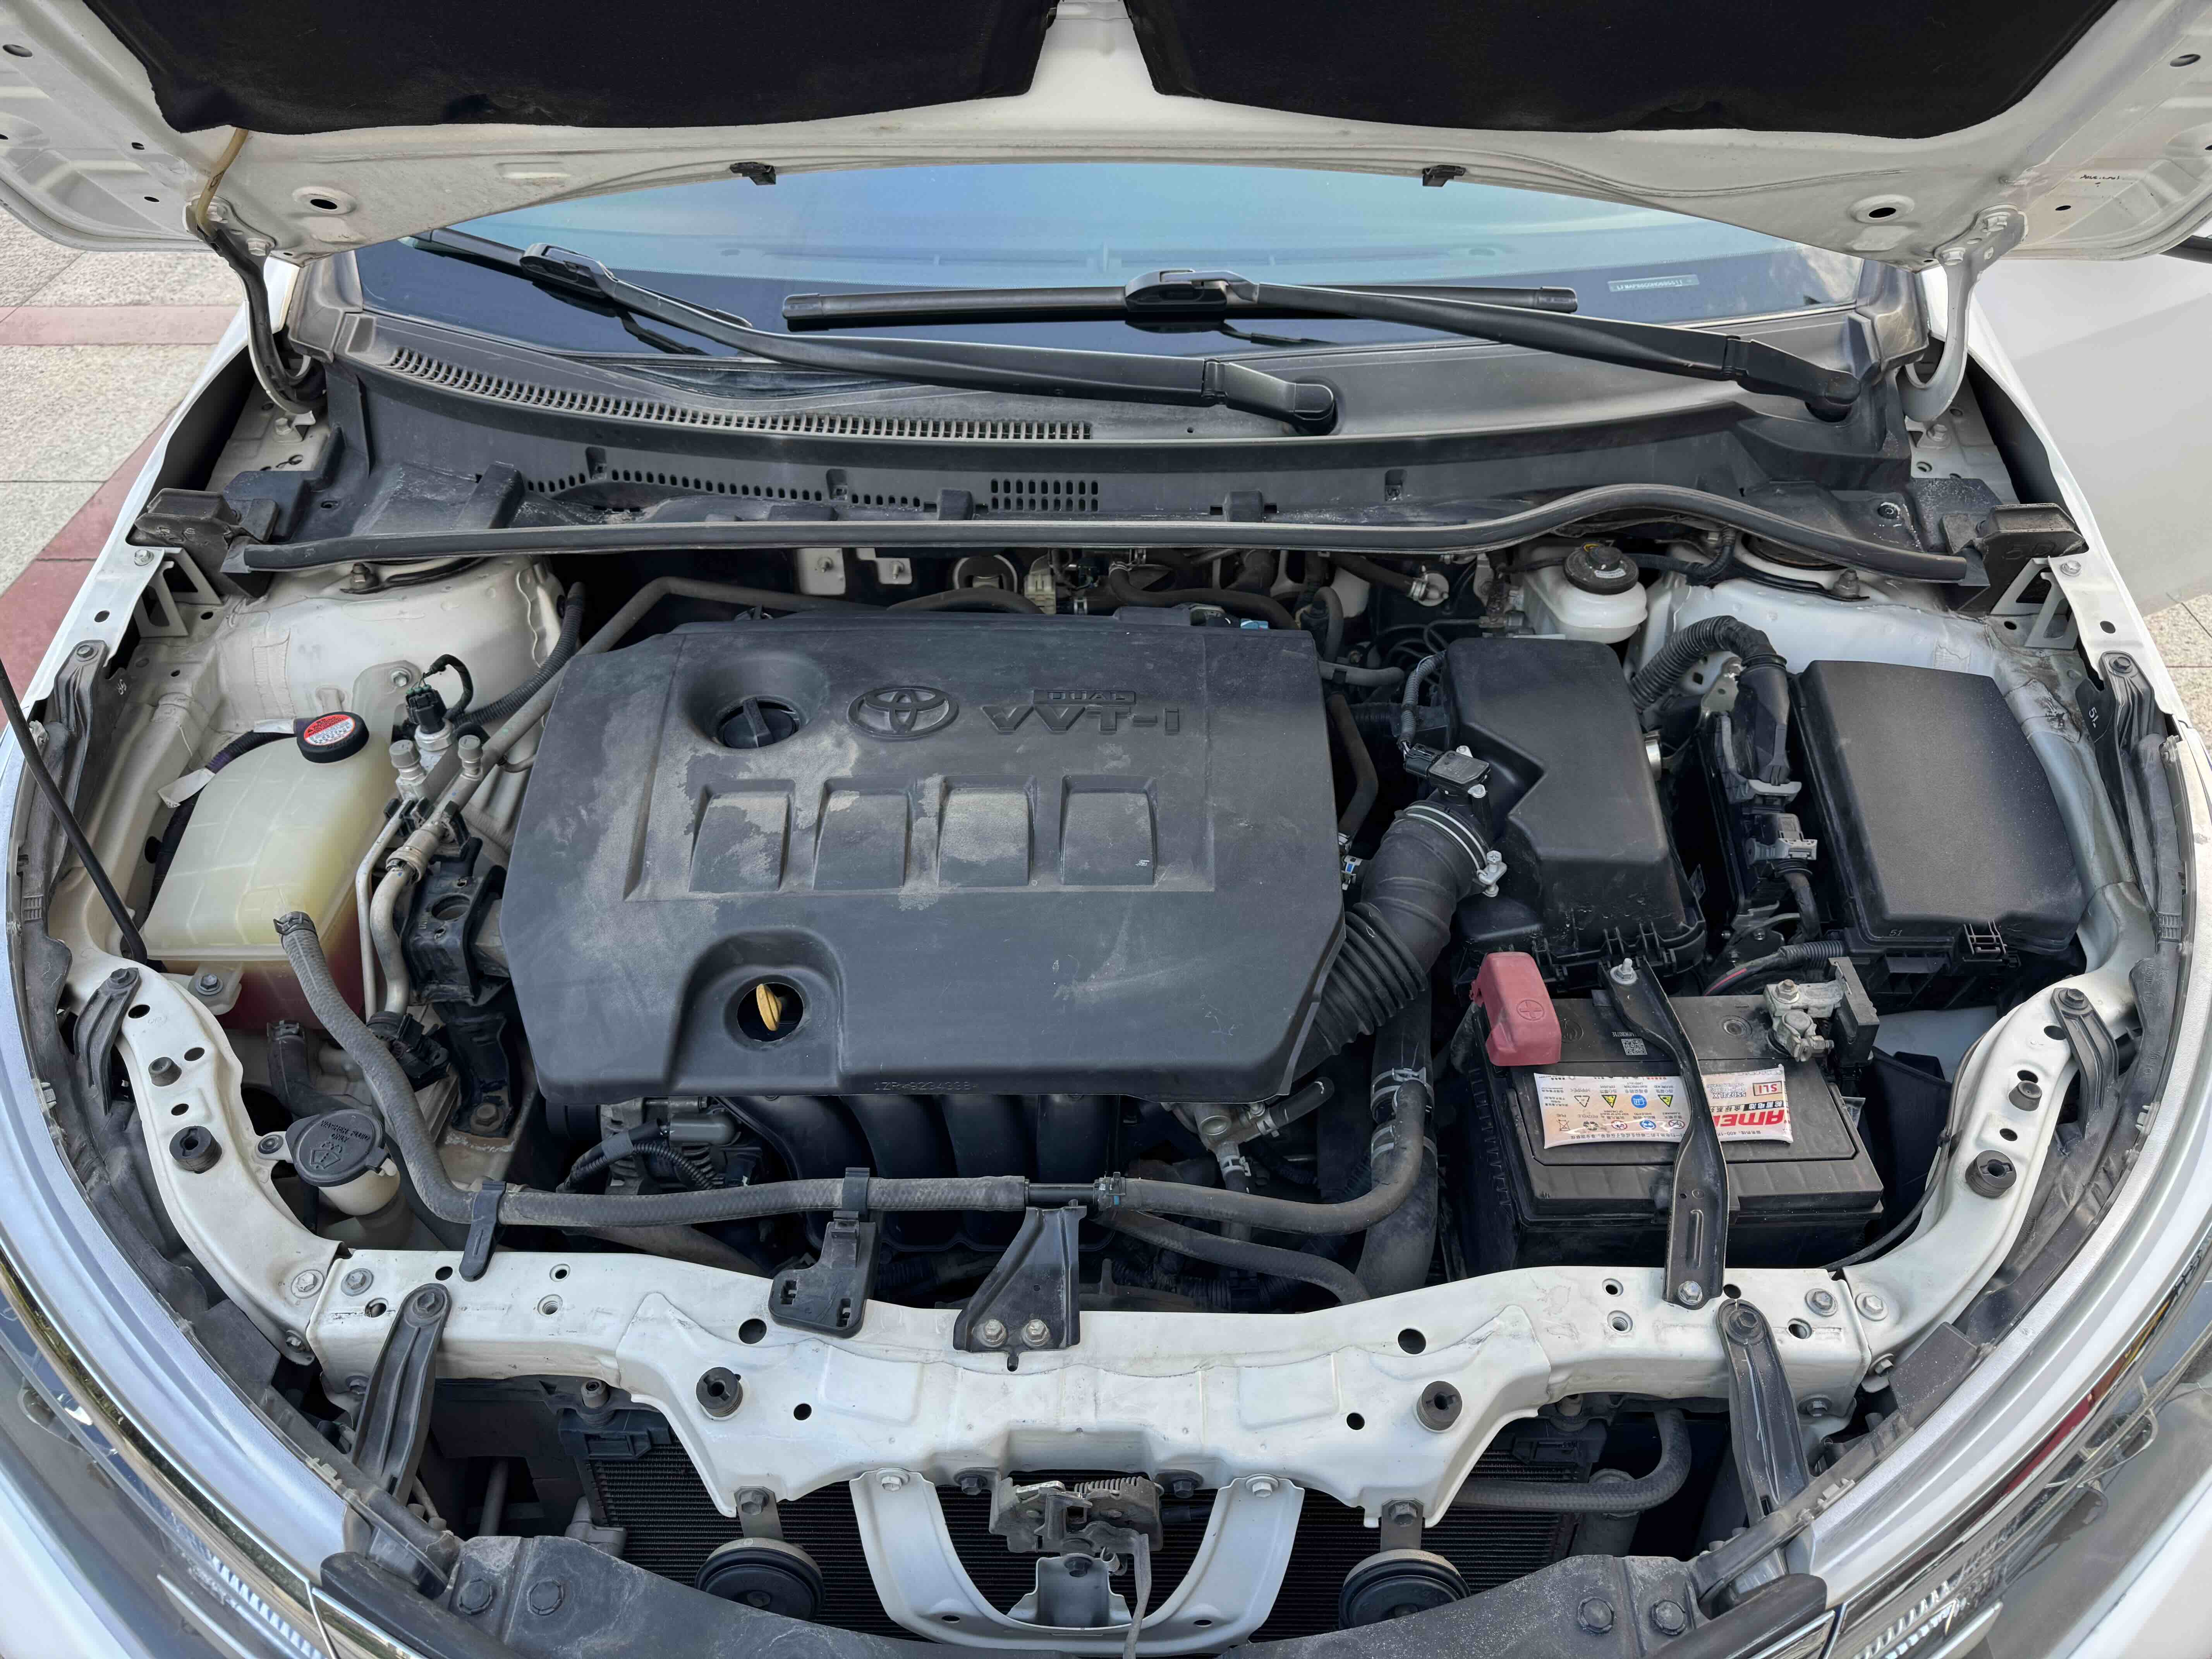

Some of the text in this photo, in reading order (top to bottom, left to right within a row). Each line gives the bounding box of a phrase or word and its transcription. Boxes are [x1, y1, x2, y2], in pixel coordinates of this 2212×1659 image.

[1048, 691, 1126, 701] DUAL
[1759, 1084, 1778, 1092] SLI
[320, 1120, 370, 1141] WASHER FLUID
[331, 1133, 350, 1143] ONLY
